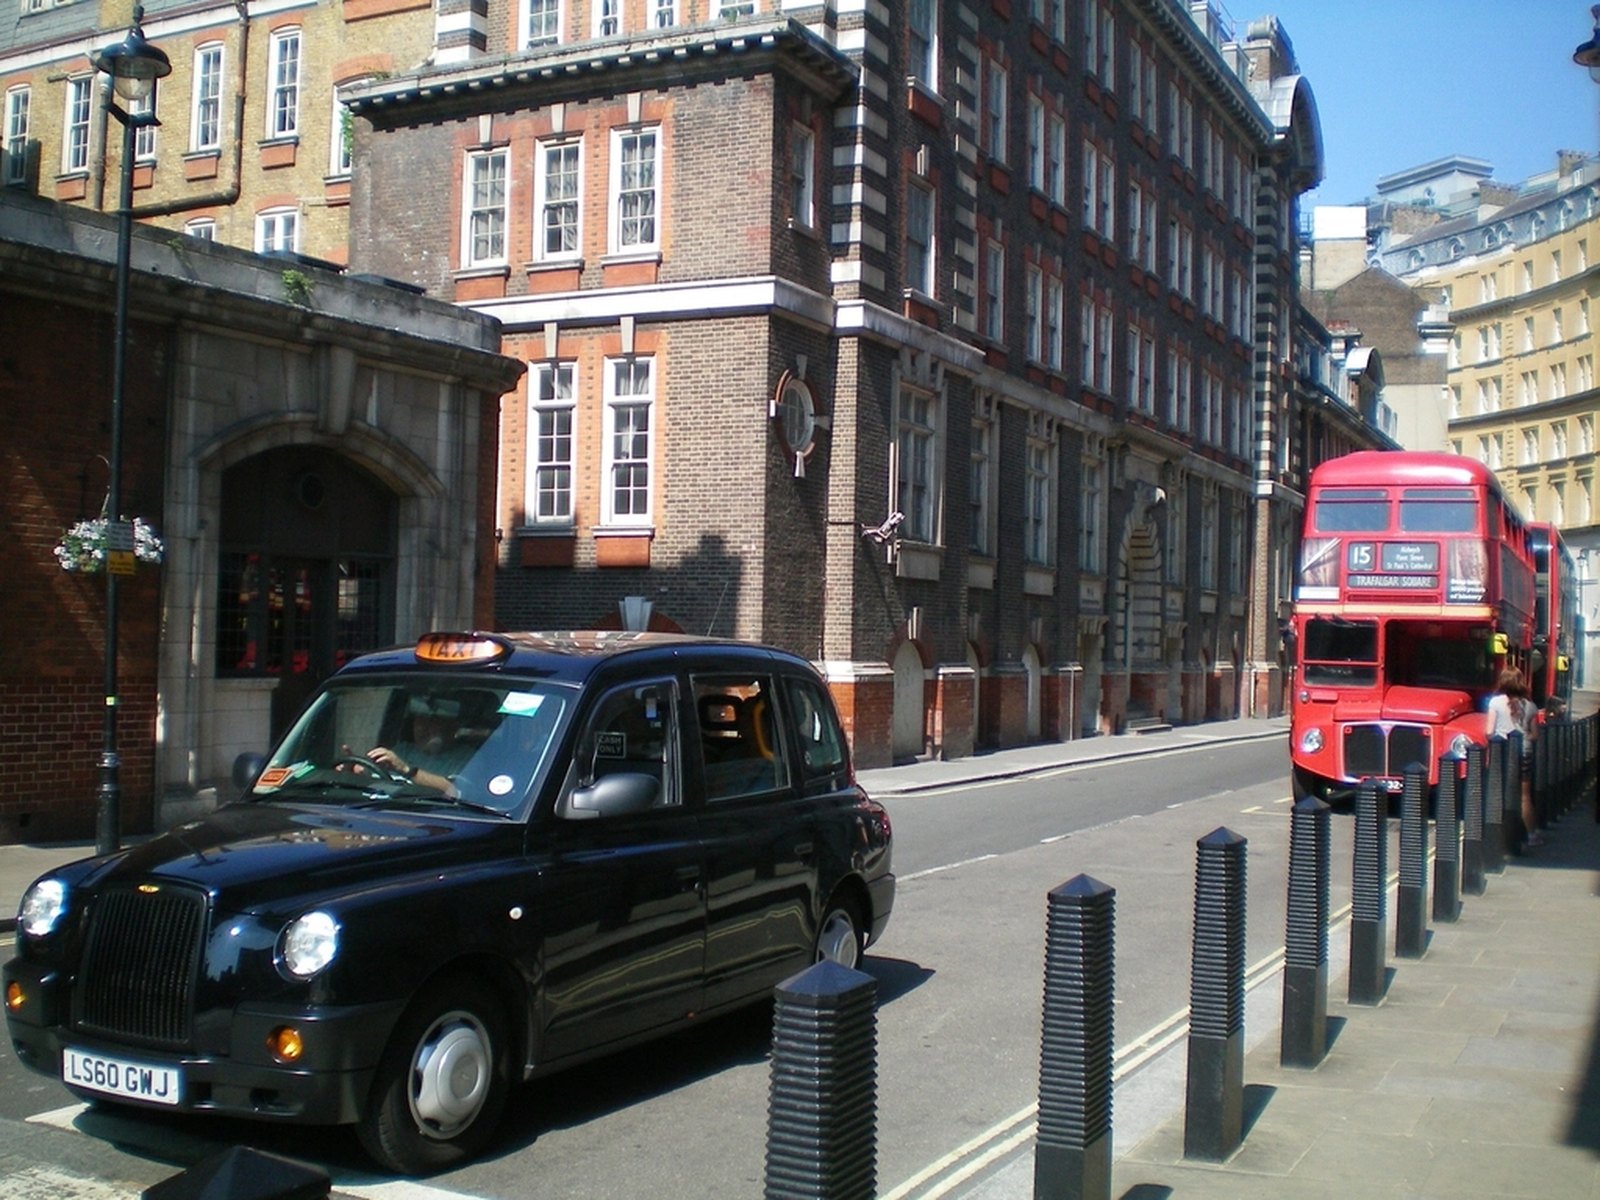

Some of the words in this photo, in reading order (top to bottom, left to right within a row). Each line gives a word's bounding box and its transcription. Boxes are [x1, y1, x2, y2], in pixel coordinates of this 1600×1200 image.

[1353, 546, 1371, 565] 15
[1356, 575, 1400, 586] TRAFALGAR
[1402, 576, 1432, 587] SQUARE
[427, 638, 477, 659] TAXI
[599, 735, 622, 745] CASH
[599, 745, 621, 754] ONLY
[71, 1054, 119, 1088] LS60
[125, 1066, 168, 1097] GWJ
